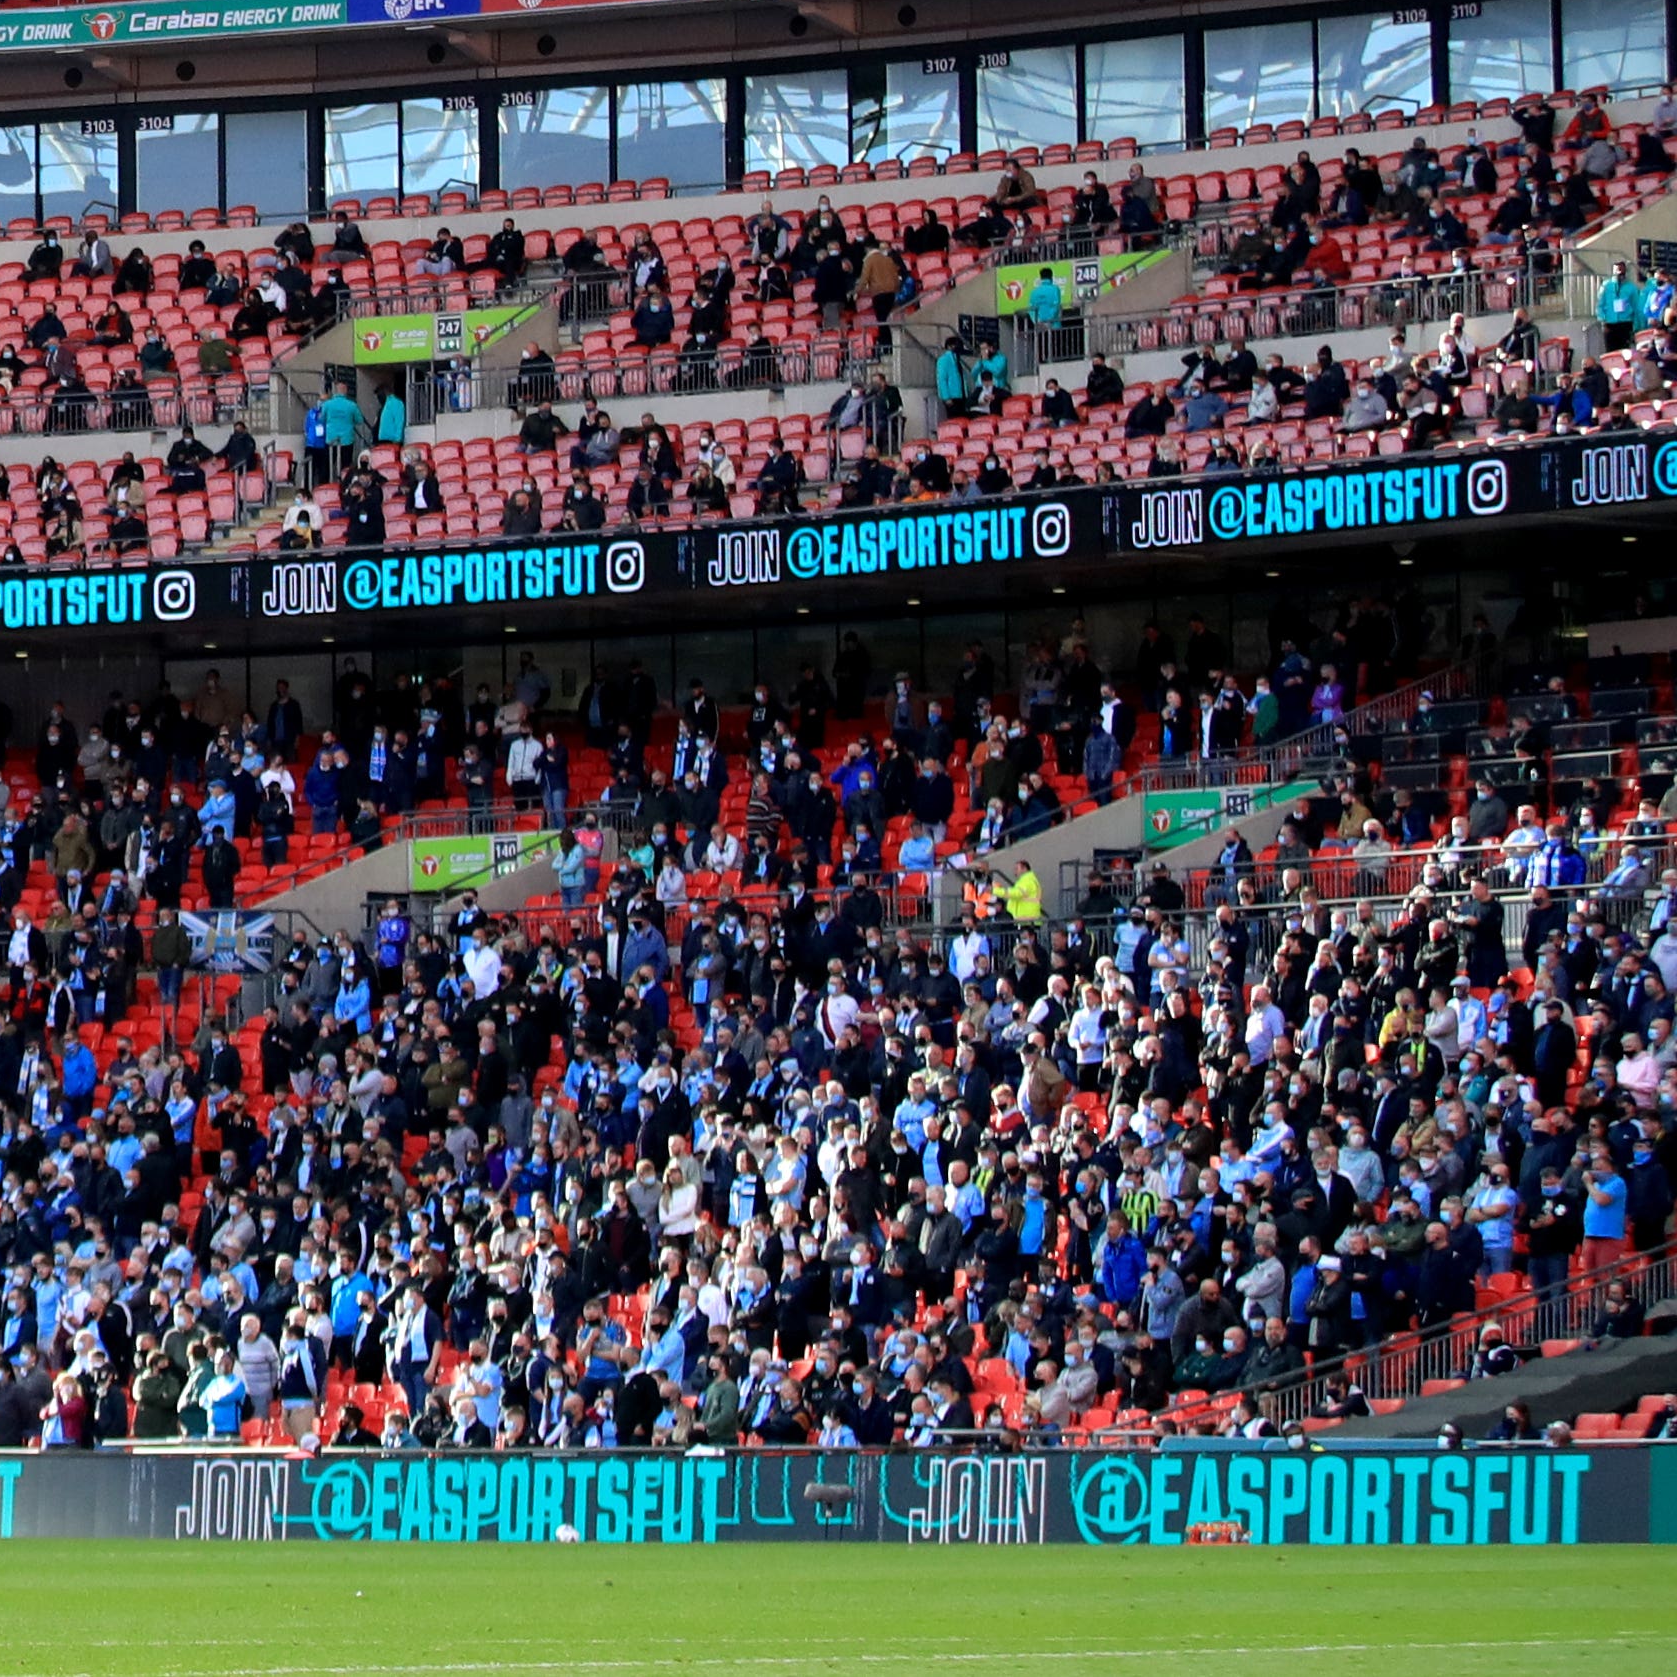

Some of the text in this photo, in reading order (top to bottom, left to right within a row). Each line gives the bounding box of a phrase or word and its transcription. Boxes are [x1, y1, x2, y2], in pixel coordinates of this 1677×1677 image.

[1396, 9, 1427, 23] 3109
[1451, 3, 1477, 18] 3110
[130, 4, 340, 32] Carabao ENERGY DRINK
[23, 24, 72, 40] DRINK
[926, 58, 955, 72] 3107
[978, 53, 1007, 67] 3108
[445, 96, 475, 110] 3105
[501, 92, 533, 106] 3106
[84, 119, 114, 133] 3103
[139, 117, 171, 130] 3104
[1077, 268, 1096, 280] 248
[438, 323, 459, 334] 247
[1573, 444, 1647, 506] JOIN
[1132, 465, 1459, 548] JOIN @EASPORTSFUT
[708, 508, 1025, 586] JOIN @EASPORTSFUT
[262, 545, 599, 616] JOIN @EASPORTSFUT
[496, 844, 516, 858] 140
[176, 1458, 727, 1542] JOIN @EASPORTSFUT
[908, 1454, 1590, 1545] JOIN @EASPORTSFUT
